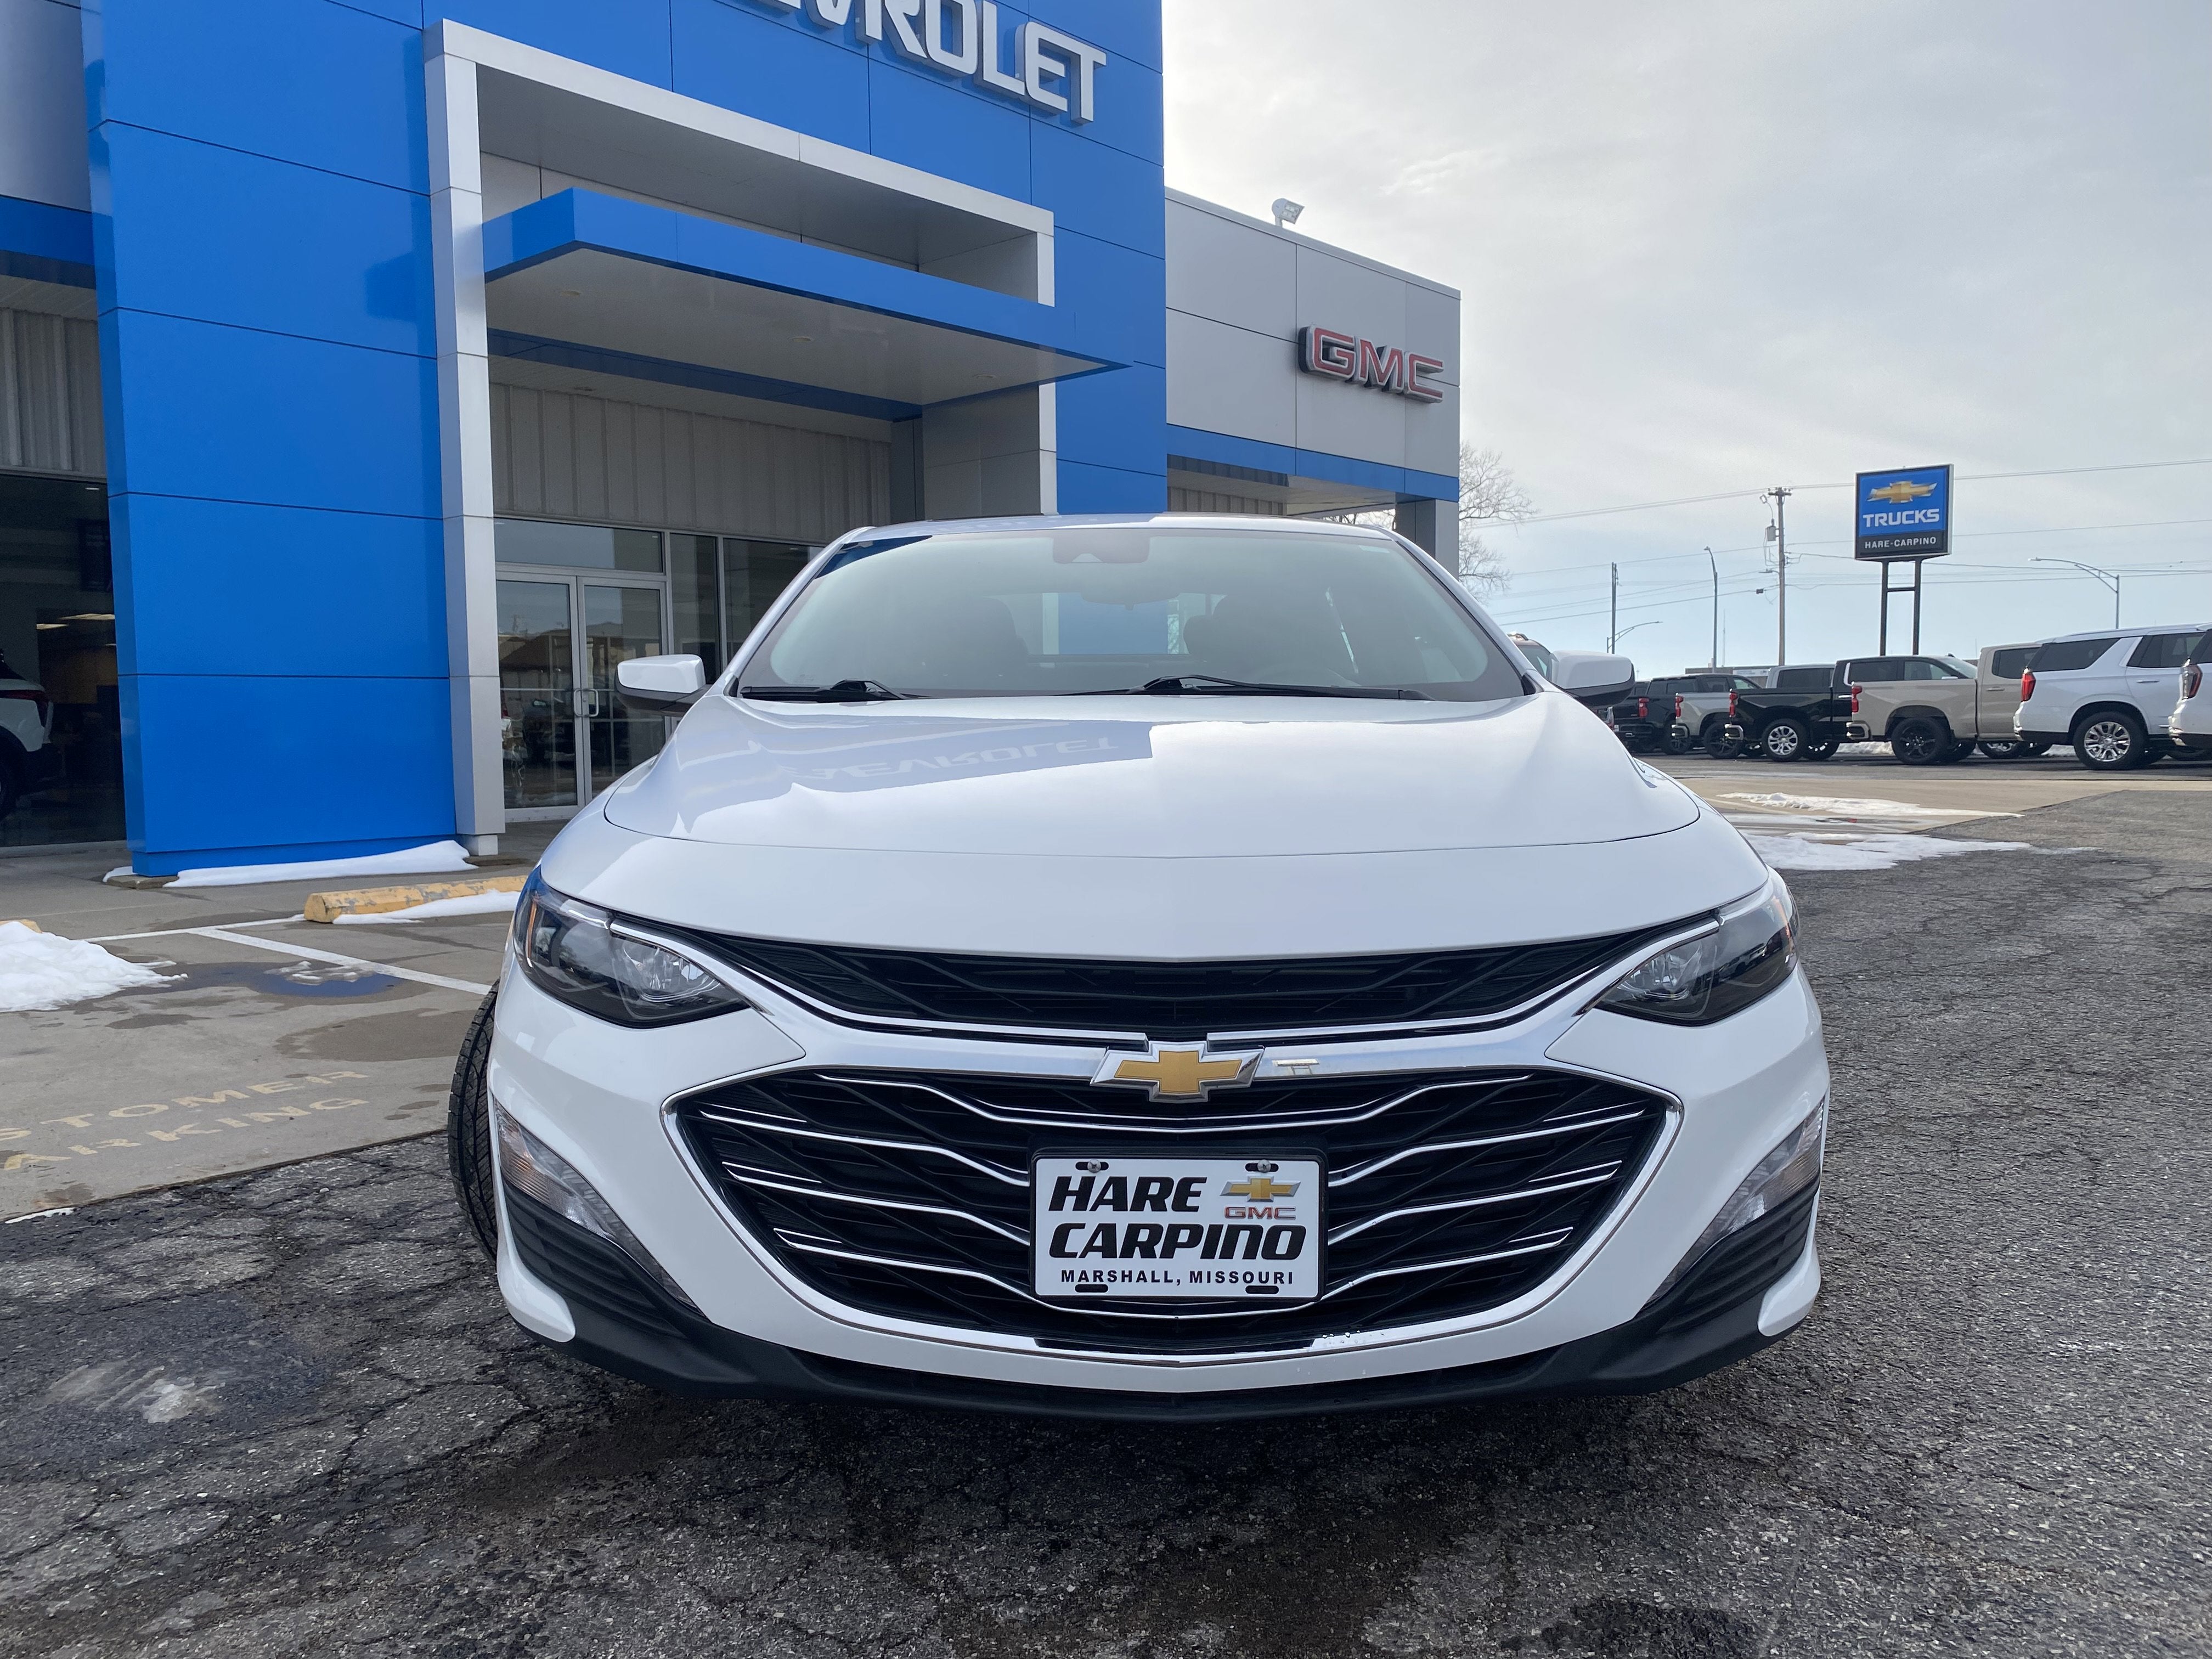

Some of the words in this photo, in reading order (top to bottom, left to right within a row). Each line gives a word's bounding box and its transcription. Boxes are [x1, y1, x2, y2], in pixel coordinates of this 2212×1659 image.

[1306, 326, 1444, 403] GMC
[1863, 508, 1940, 528] TRUCKS
[1865, 537, 1937, 549] HARE-CARPINO
[1048, 1176, 1207, 1212] HARE
[1224, 1206, 1296, 1220] GMC
[1049, 1223, 1306, 1260] CARPINO
[1061, 1269, 1181, 1286] MARSHALL,
[1189, 1271, 1294, 1284] MISSOURI
